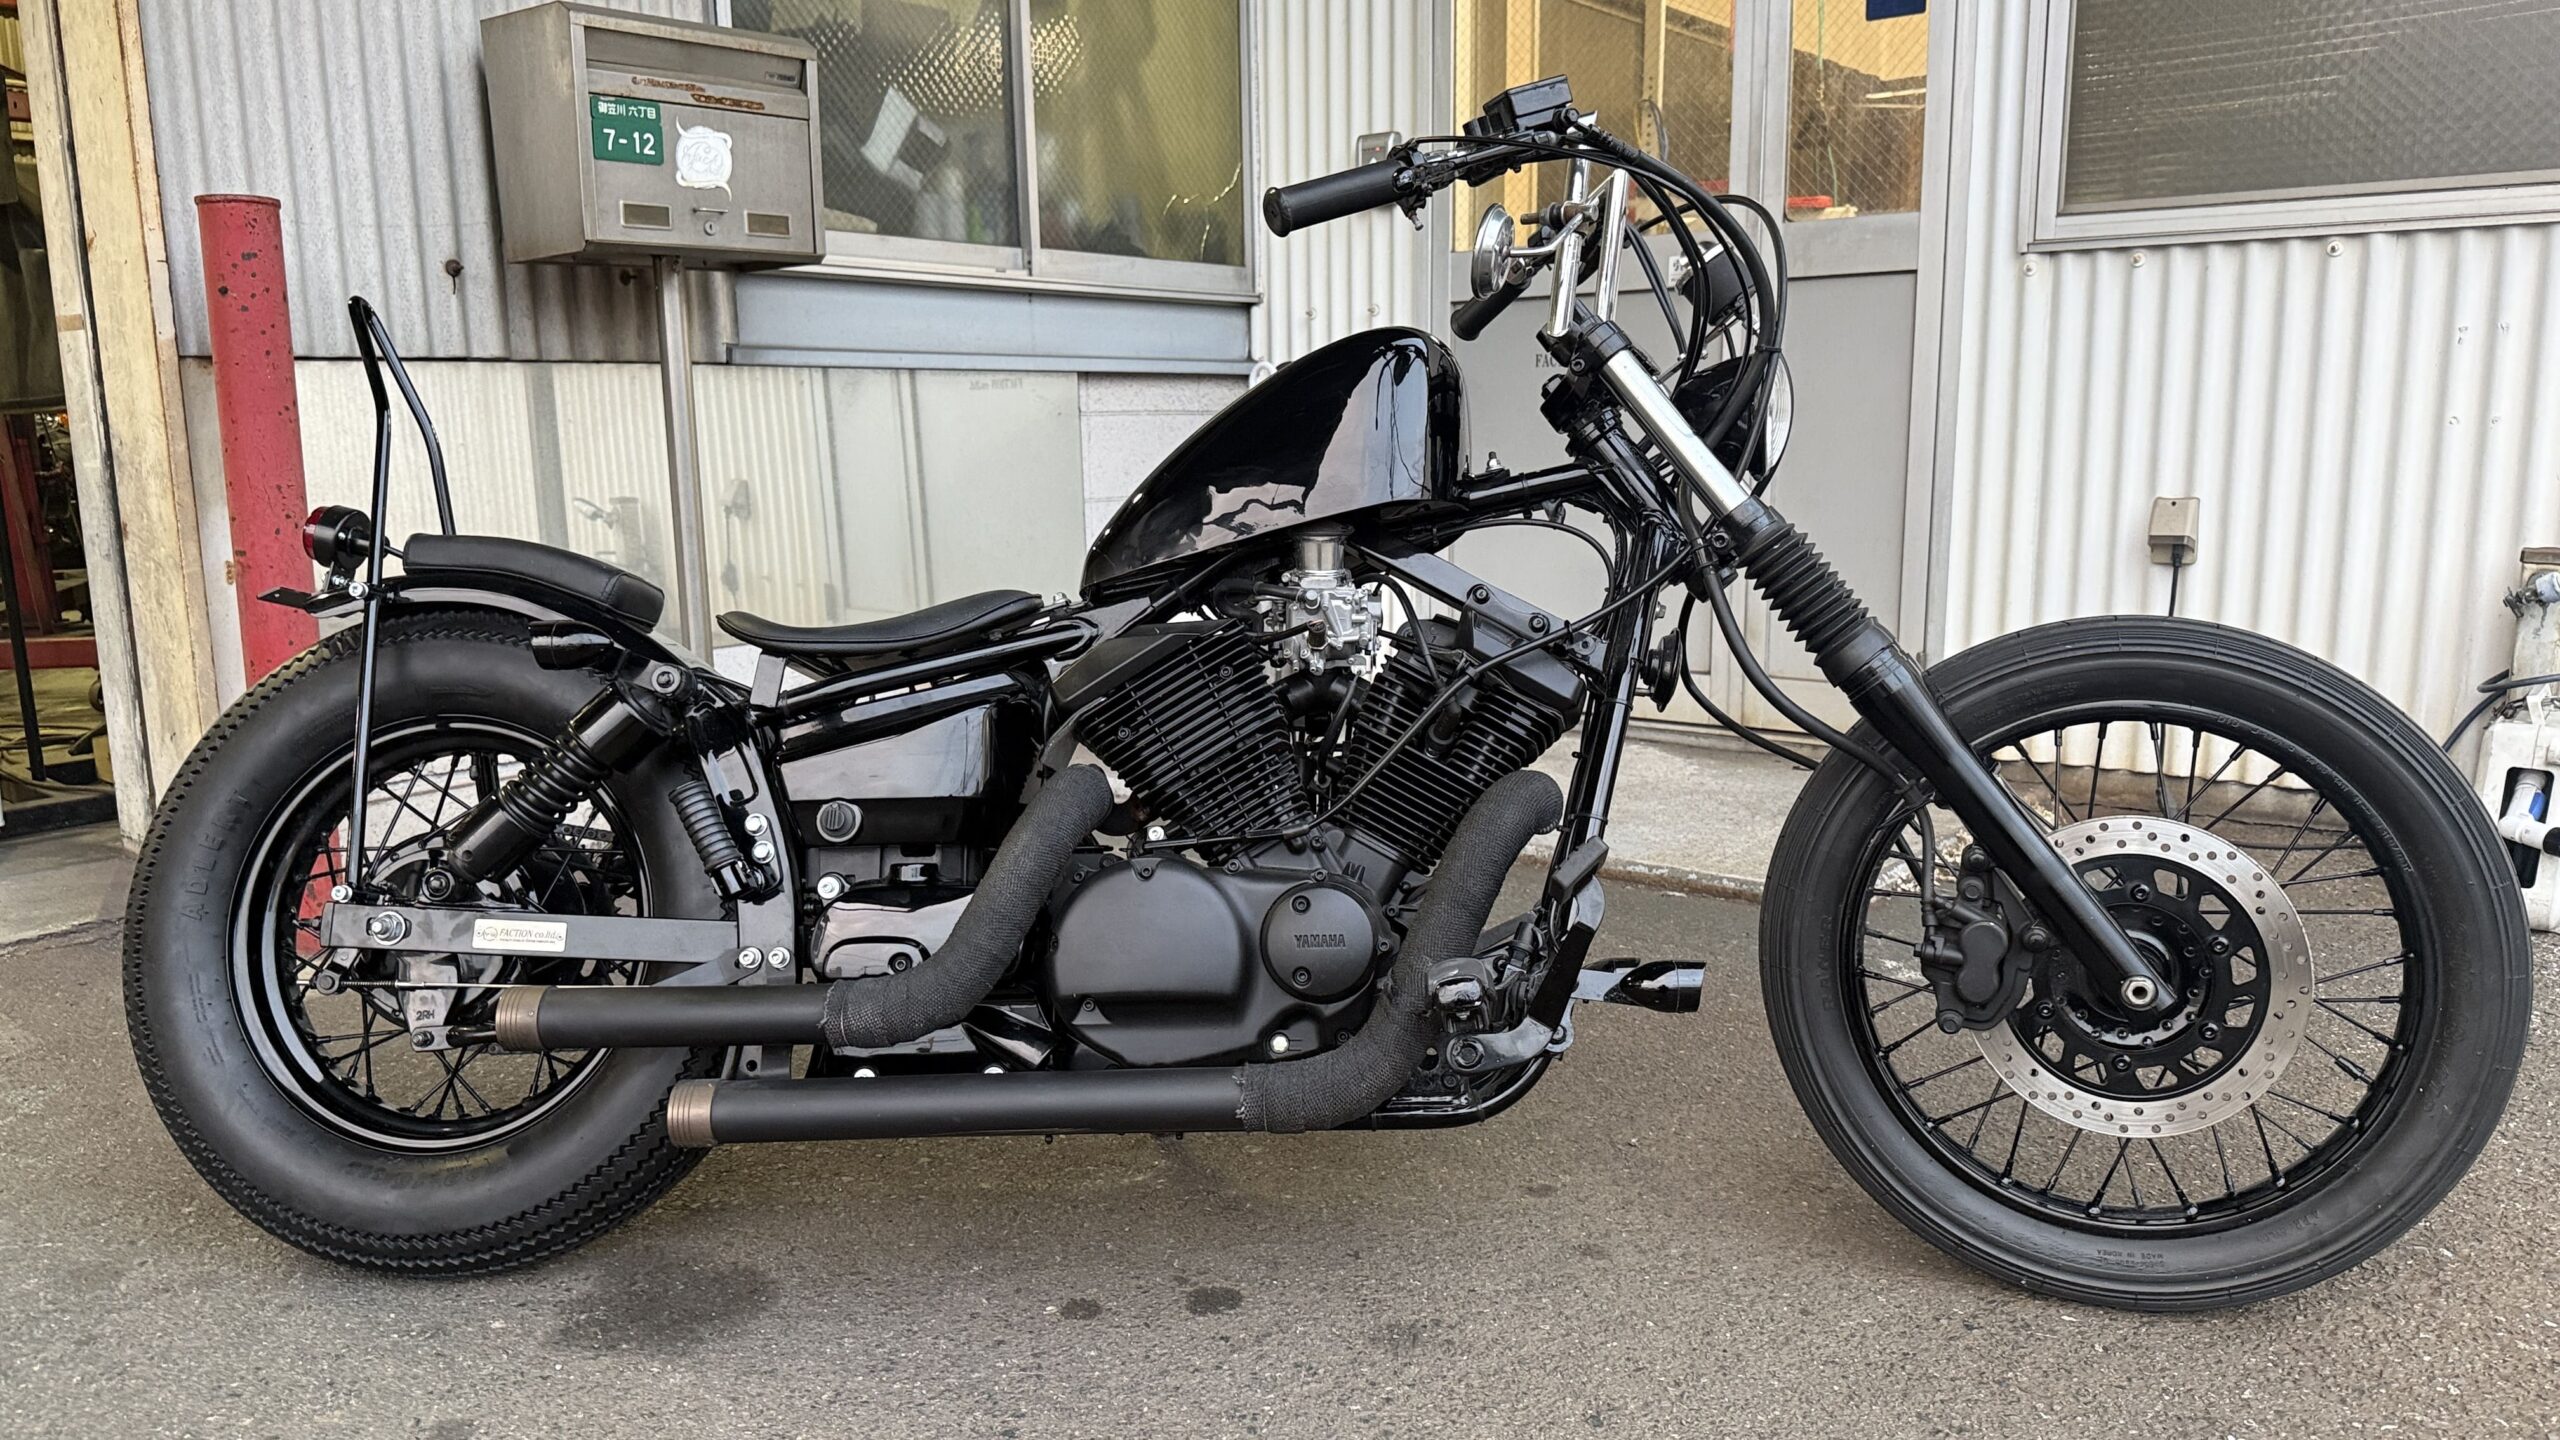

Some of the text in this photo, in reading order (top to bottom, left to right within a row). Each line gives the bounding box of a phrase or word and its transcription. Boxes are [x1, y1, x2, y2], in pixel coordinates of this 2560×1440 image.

[602, 128, 656, 155] 7-12
[499, 927, 533, 938] FACTION
[1294, 933, 1346, 949] YAMAHA
[415, 1009, 436, 1021] 2RH
[2096, 1249, 2123, 1258] KOREA
